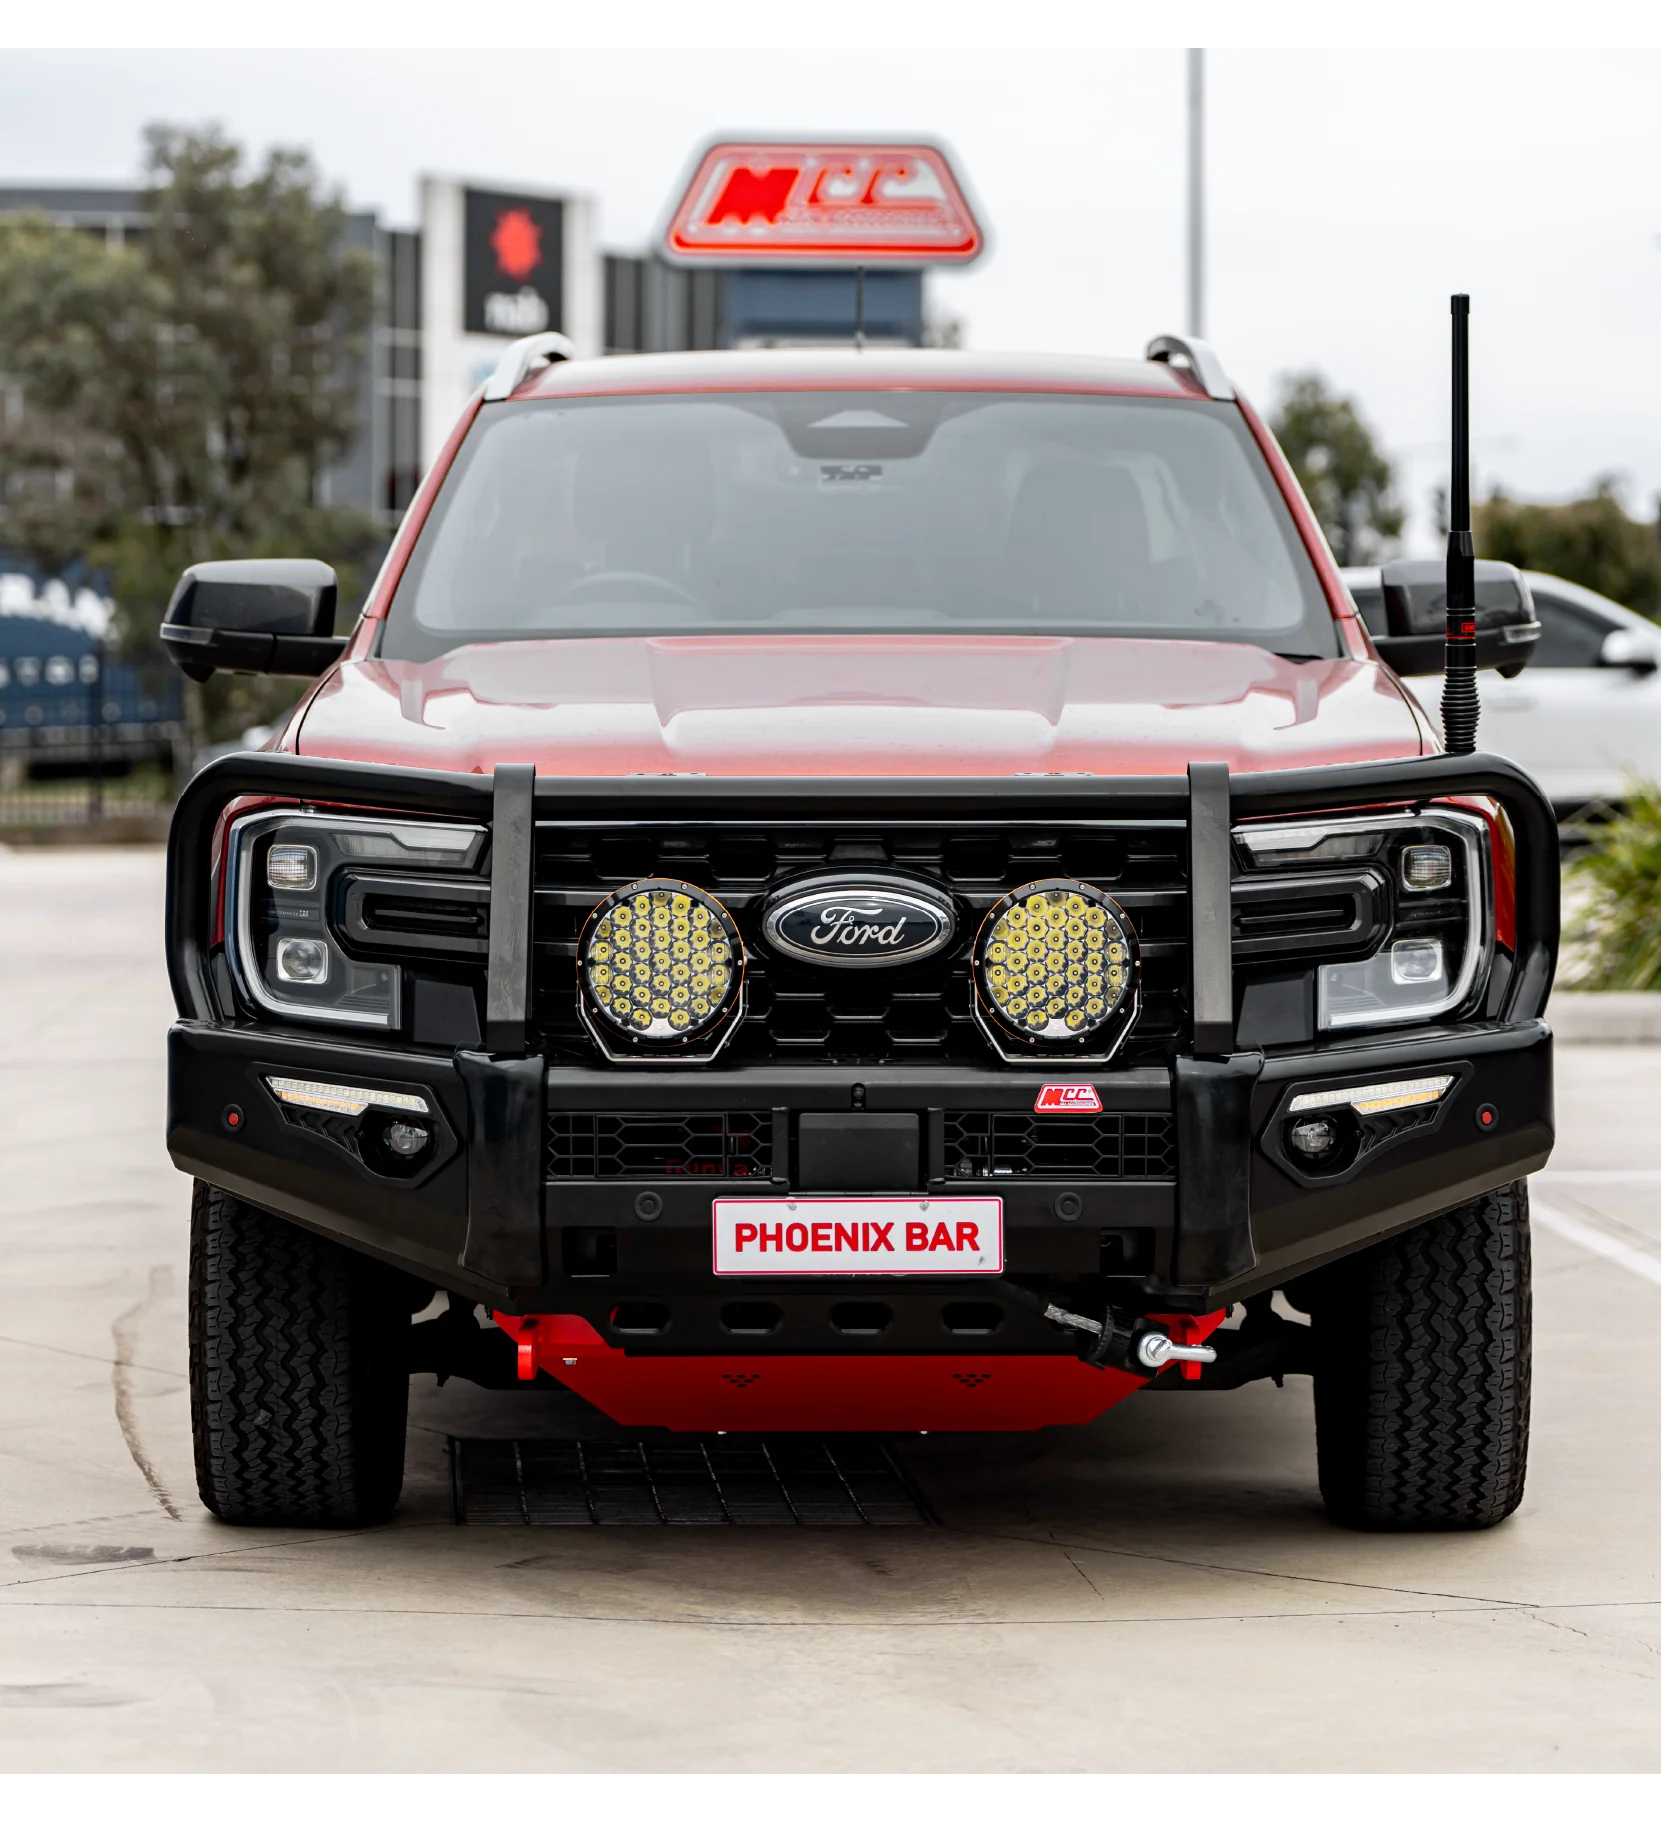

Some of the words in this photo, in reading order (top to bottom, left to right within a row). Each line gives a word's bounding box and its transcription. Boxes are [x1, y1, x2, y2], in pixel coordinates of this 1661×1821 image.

[810, 906, 907, 945] Ford
[1041, 1088, 1095, 1106] MCC
[735, 1222, 895, 1253] PHOENIX
[905, 1221, 980, 1252] BAR
